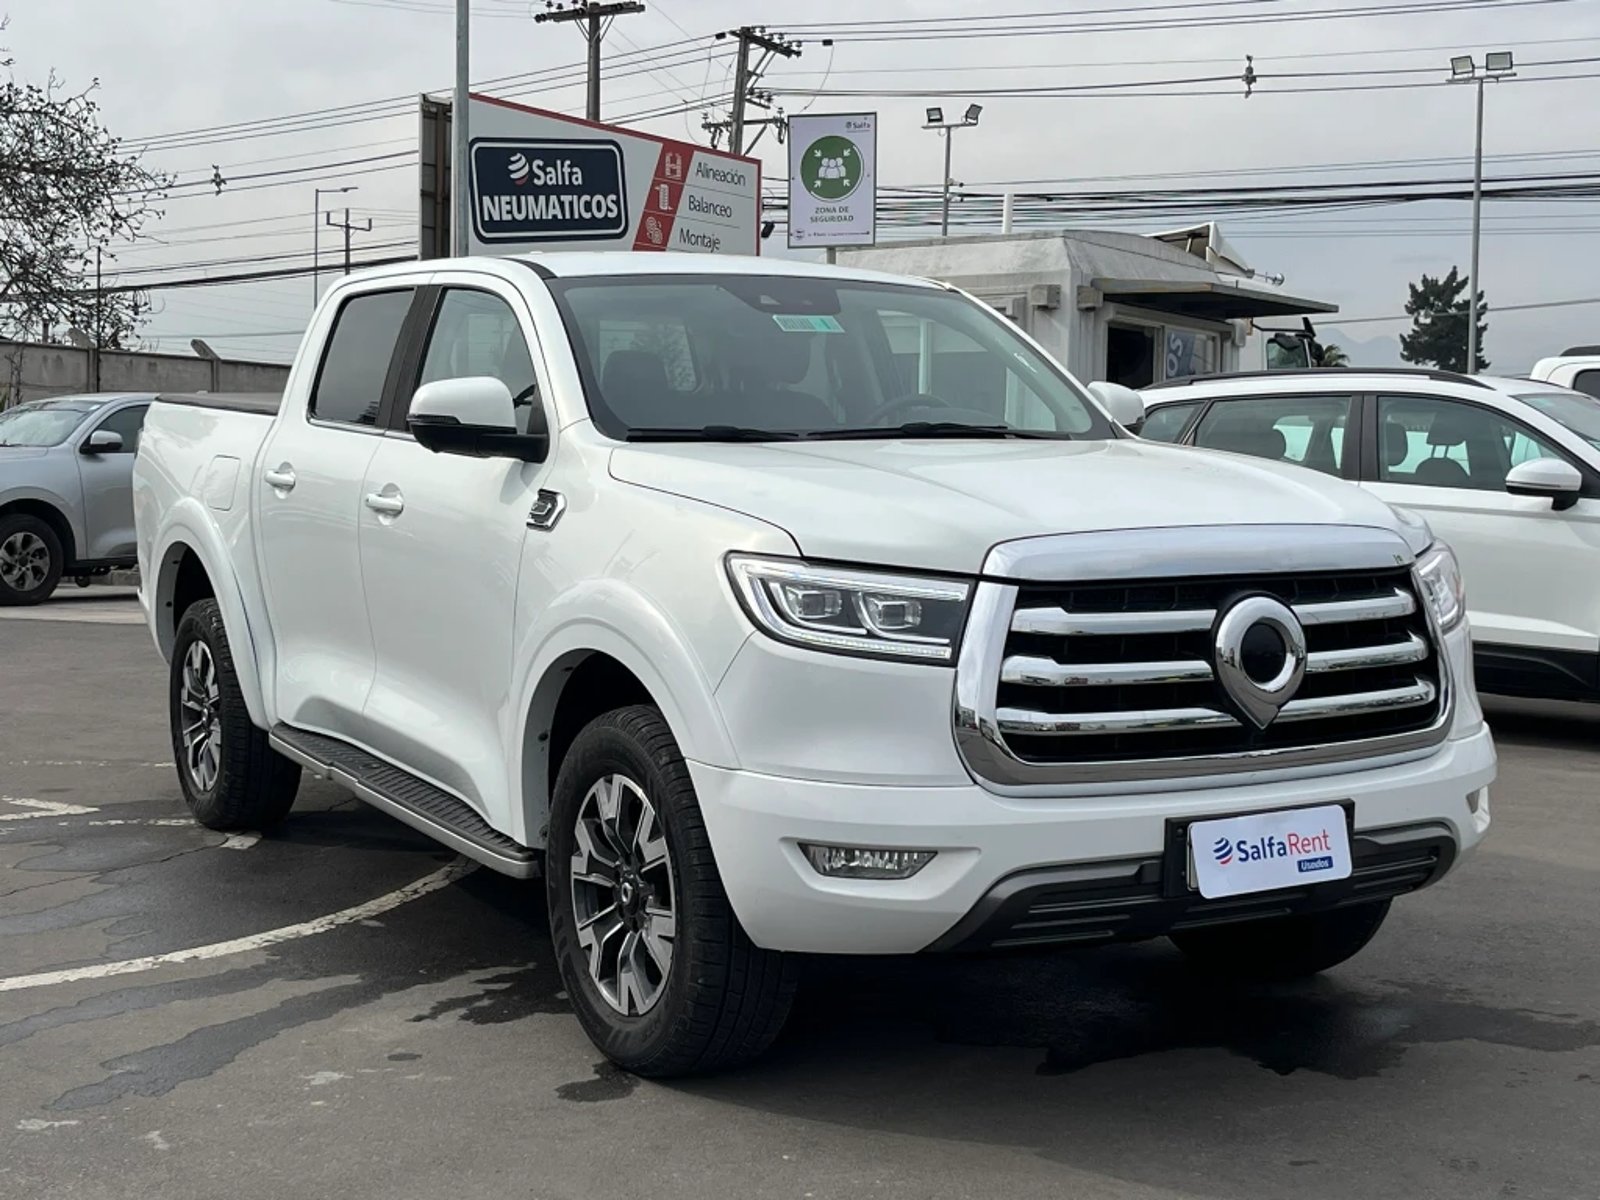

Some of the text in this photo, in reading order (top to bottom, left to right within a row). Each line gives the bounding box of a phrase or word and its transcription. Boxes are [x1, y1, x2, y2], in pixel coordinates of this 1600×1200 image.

[532, 158, 583, 186] Salfa
[696, 162, 746, 187] Alineación
[482, 194, 618, 222] NEUMATICOS
[688, 194, 732, 218] Balanceo
[815, 206, 837, 214] ZONA
[810, 215, 854, 223] SEGURIDAD
[679, 228, 721, 253] Montaje
[1300, 859, 1329, 871] Usados
